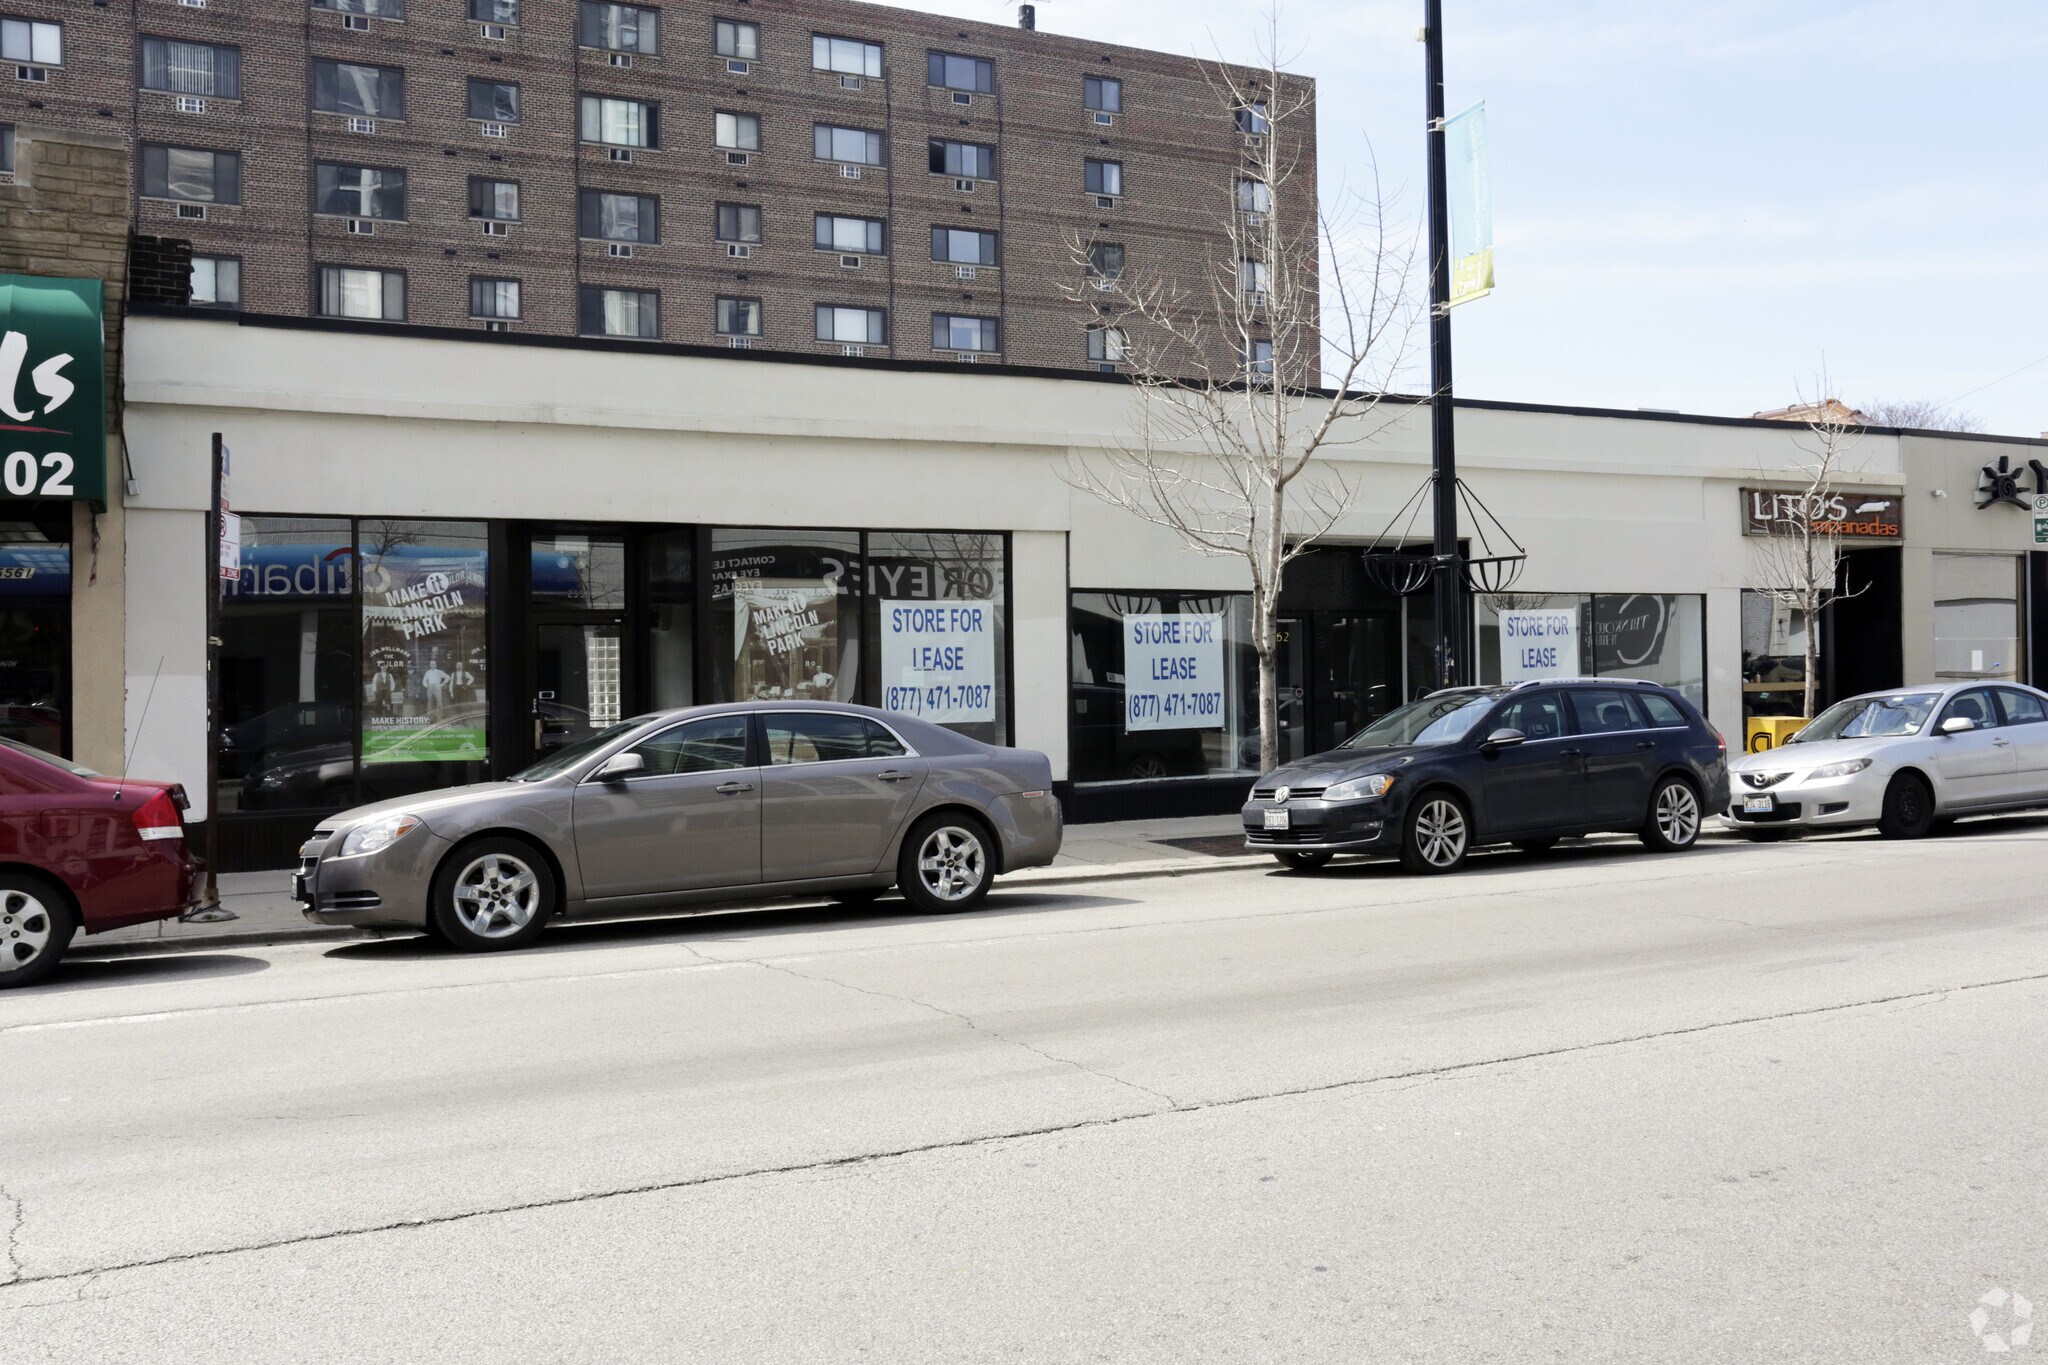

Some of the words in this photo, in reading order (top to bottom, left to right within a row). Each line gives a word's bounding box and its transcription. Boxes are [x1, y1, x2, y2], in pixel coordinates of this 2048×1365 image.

[0, 451, 74, 496] 02
[385, 582, 428, 607] MAKE
[400, 590, 464, 622] LINCOLN
[402, 613, 448, 640] PARK
[752, 605, 789, 626] MAKE
[762, 609, 819, 640] LINCOLN
[892, 608, 946, 633] STORE
[950, 608, 983, 633] FOR
[1507, 616, 1544, 637] STORE
[1546, 616, 1569, 636] FOR
[767, 631, 806, 656] PARK
[1134, 621, 1181, 644] STORE
[1184, 621, 1213, 644] FOR
[1152, 657, 1197, 680] LEASE
[1521, 647, 1557, 668] LEASE
[885, 685, 922, 716] (877)
[926, 684, 991, 710] 471-7087
[1129, 694, 1160, 723] (877)
[1164, 692, 1221, 716] 471-7087
[371, 717, 395, 725] MAKE
